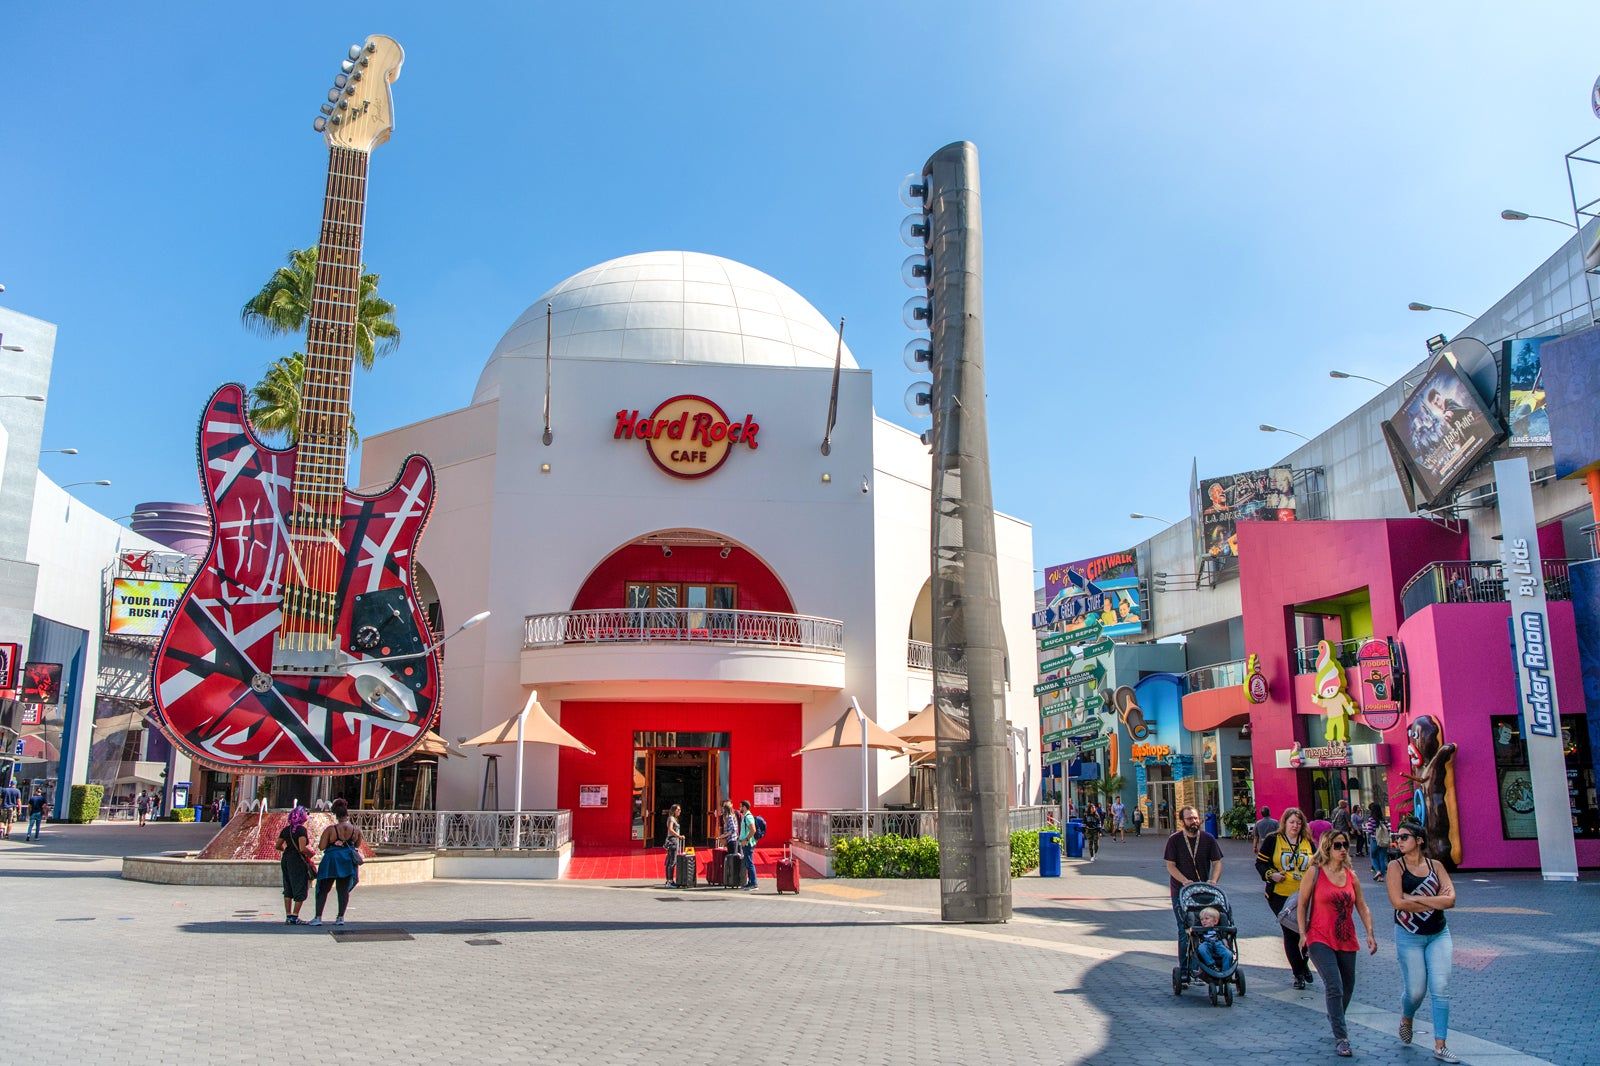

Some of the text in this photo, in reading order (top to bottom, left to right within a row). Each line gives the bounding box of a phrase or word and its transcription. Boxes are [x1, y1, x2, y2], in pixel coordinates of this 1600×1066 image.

[613, 409, 760, 450] Hard Rock
[670, 450, 707, 463] CAFE
[1086, 554, 1133, 581] CITYWALK
[121, 596, 150, 606] YOUR
[1060, 601, 1075, 620] GREAT
[1087, 594, 1101, 612] STUFF
[129, 608, 159, 618] RUSH
[1044, 637, 1064, 646] BUCA
[1075, 627, 1099, 637] BEPPO
[1513, 538, 1556, 738] Locker Room By Lids
[1042, 656, 1073, 670] CINNABON
[1035, 682, 1060, 693] SAMBA
[1061, 722, 1100, 736] Margaritaville
